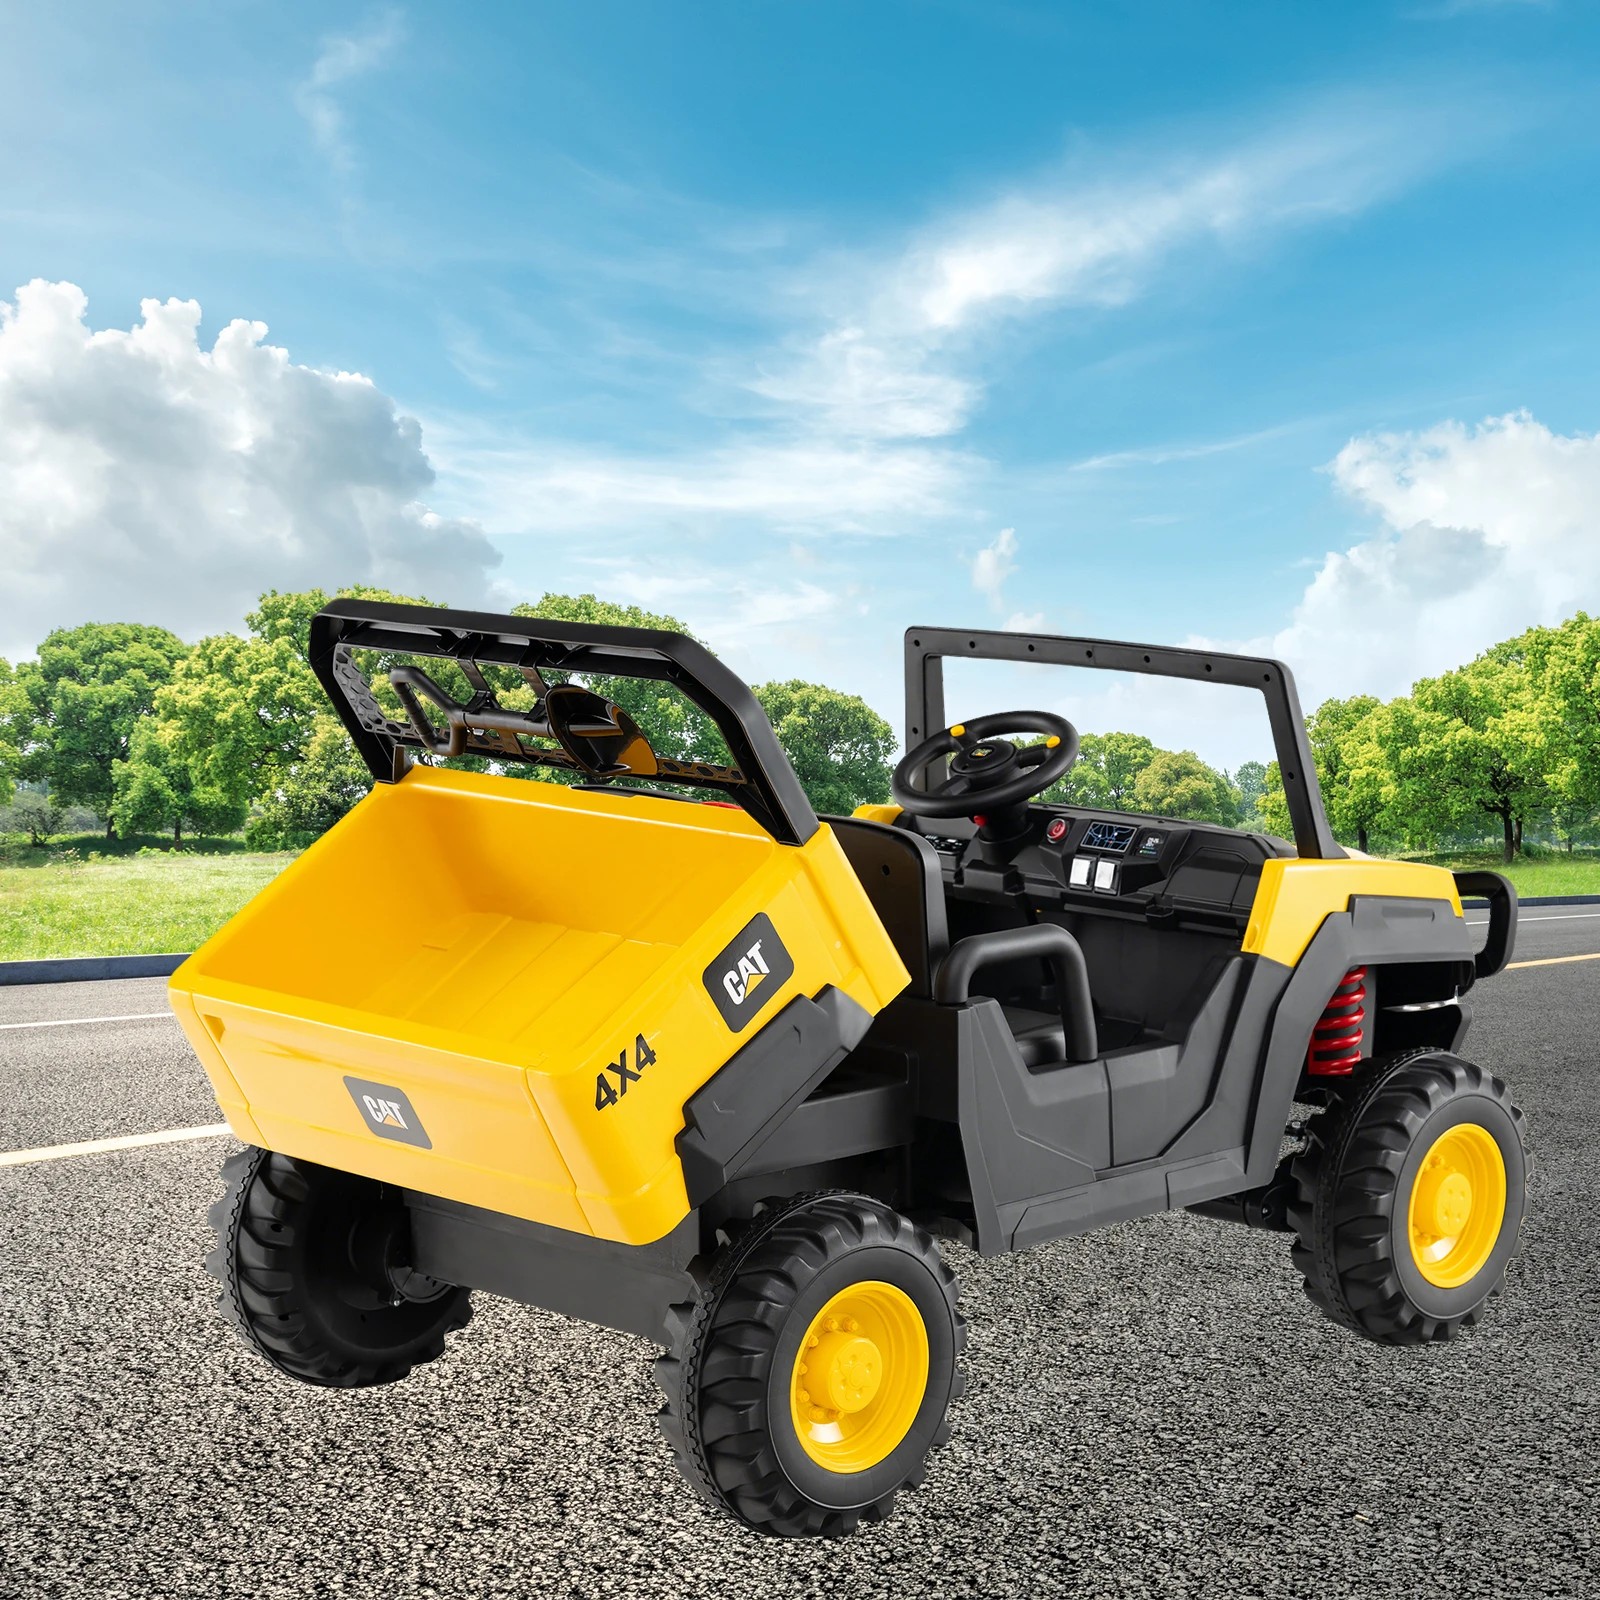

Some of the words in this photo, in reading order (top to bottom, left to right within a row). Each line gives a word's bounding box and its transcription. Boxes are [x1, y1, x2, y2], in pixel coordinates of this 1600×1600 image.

[723, 941, 769, 1005] CAT
[595, 1033, 657, 1111] 4X4
[362, 1095, 409, 1130] CAT
